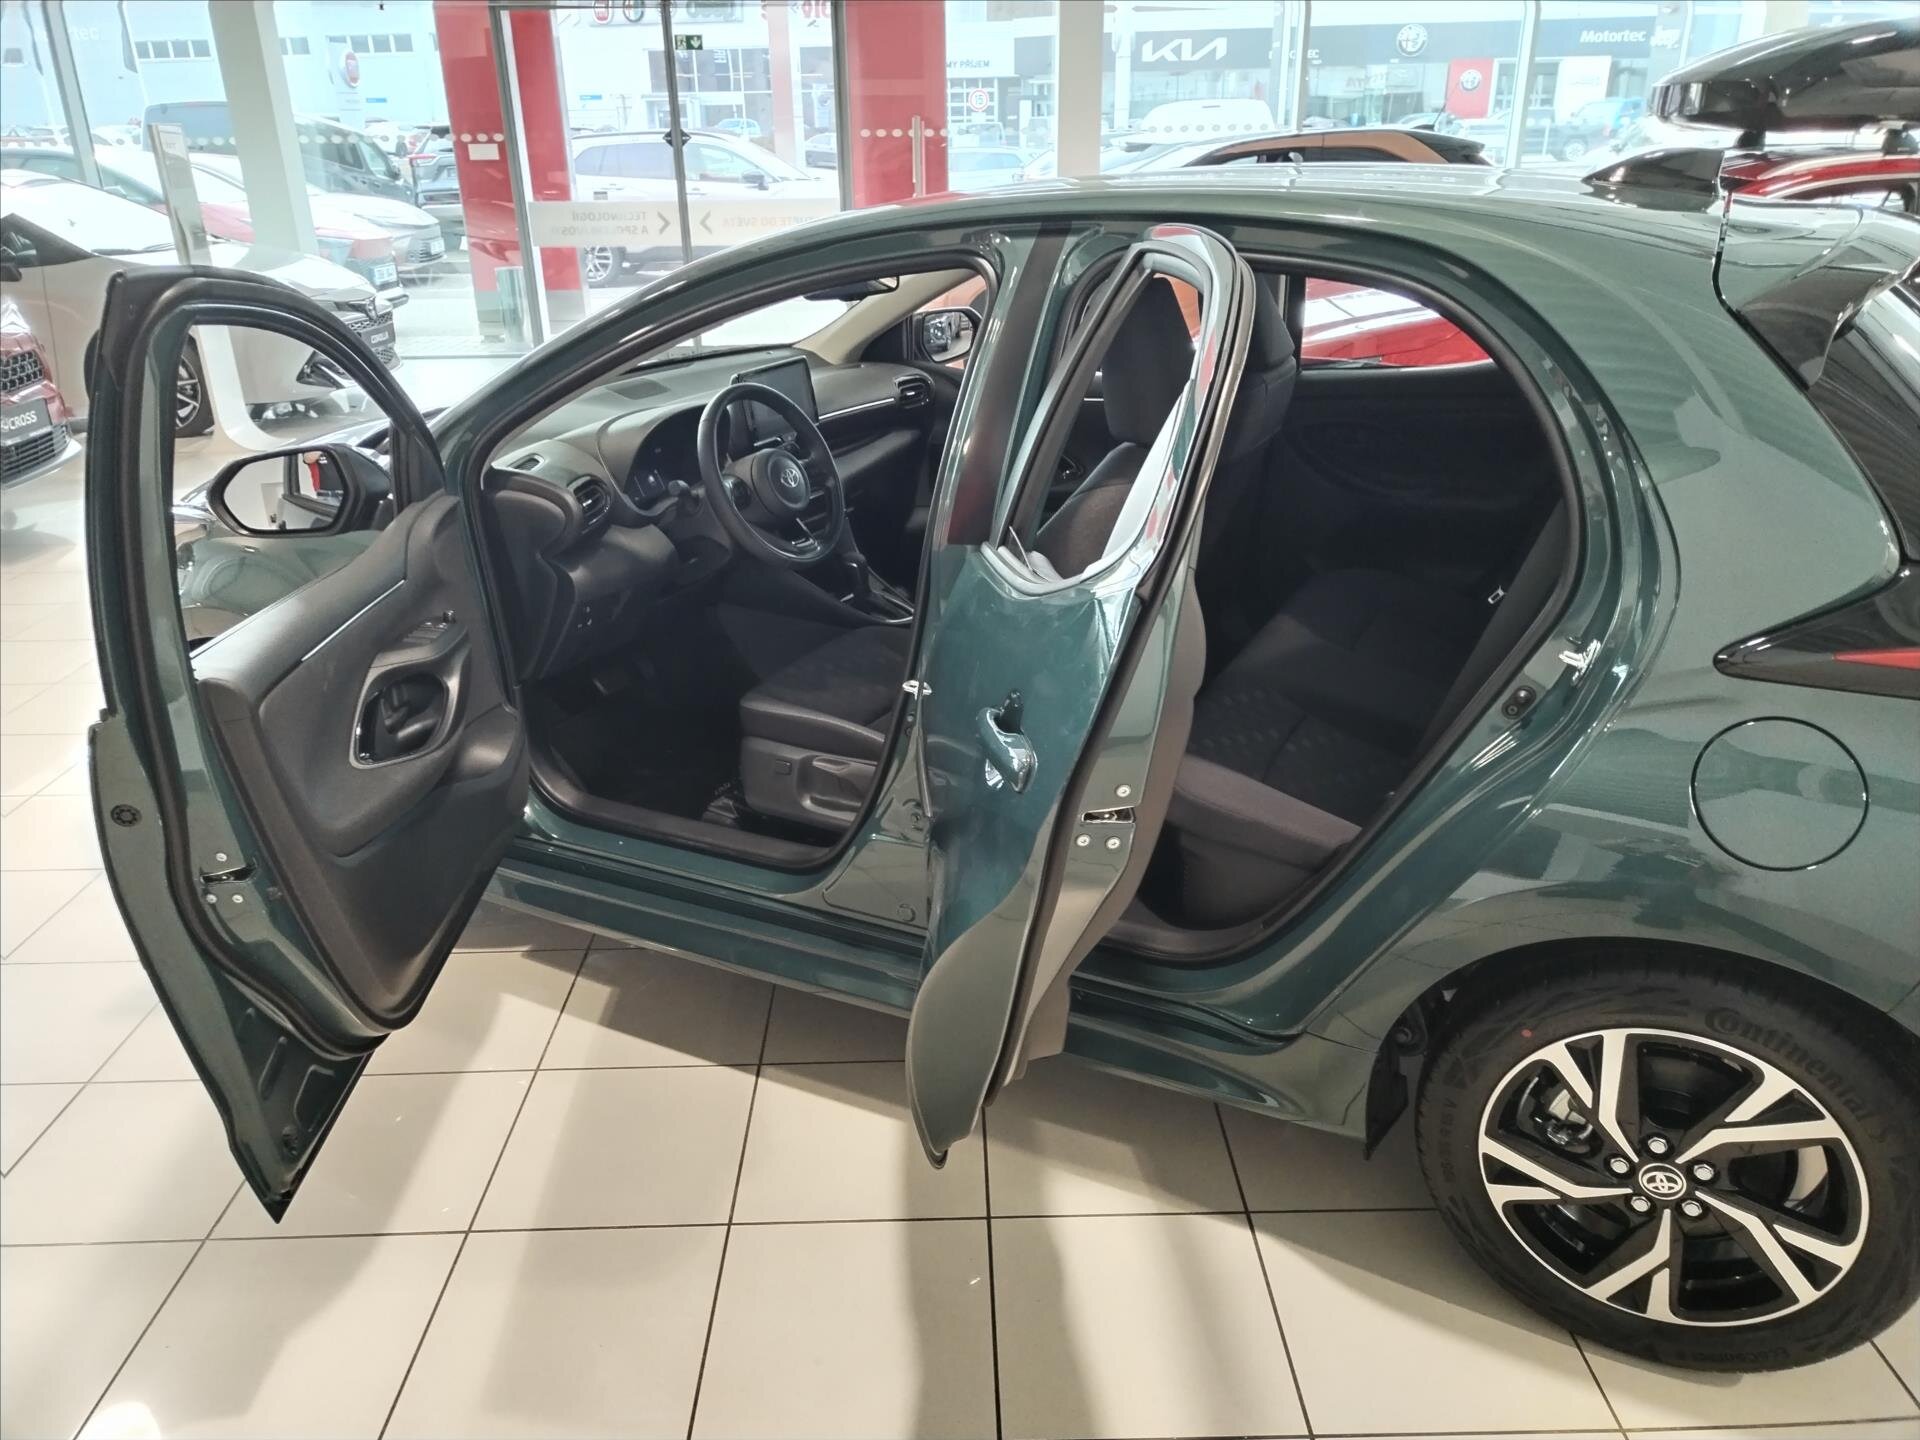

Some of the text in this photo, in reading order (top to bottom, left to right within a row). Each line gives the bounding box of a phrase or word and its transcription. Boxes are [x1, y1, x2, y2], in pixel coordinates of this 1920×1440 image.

[1580, 30, 1647, 43] Motortec
[1142, 37, 1227, 62] KIA
[1705, 1007, 1873, 1122] Continental
